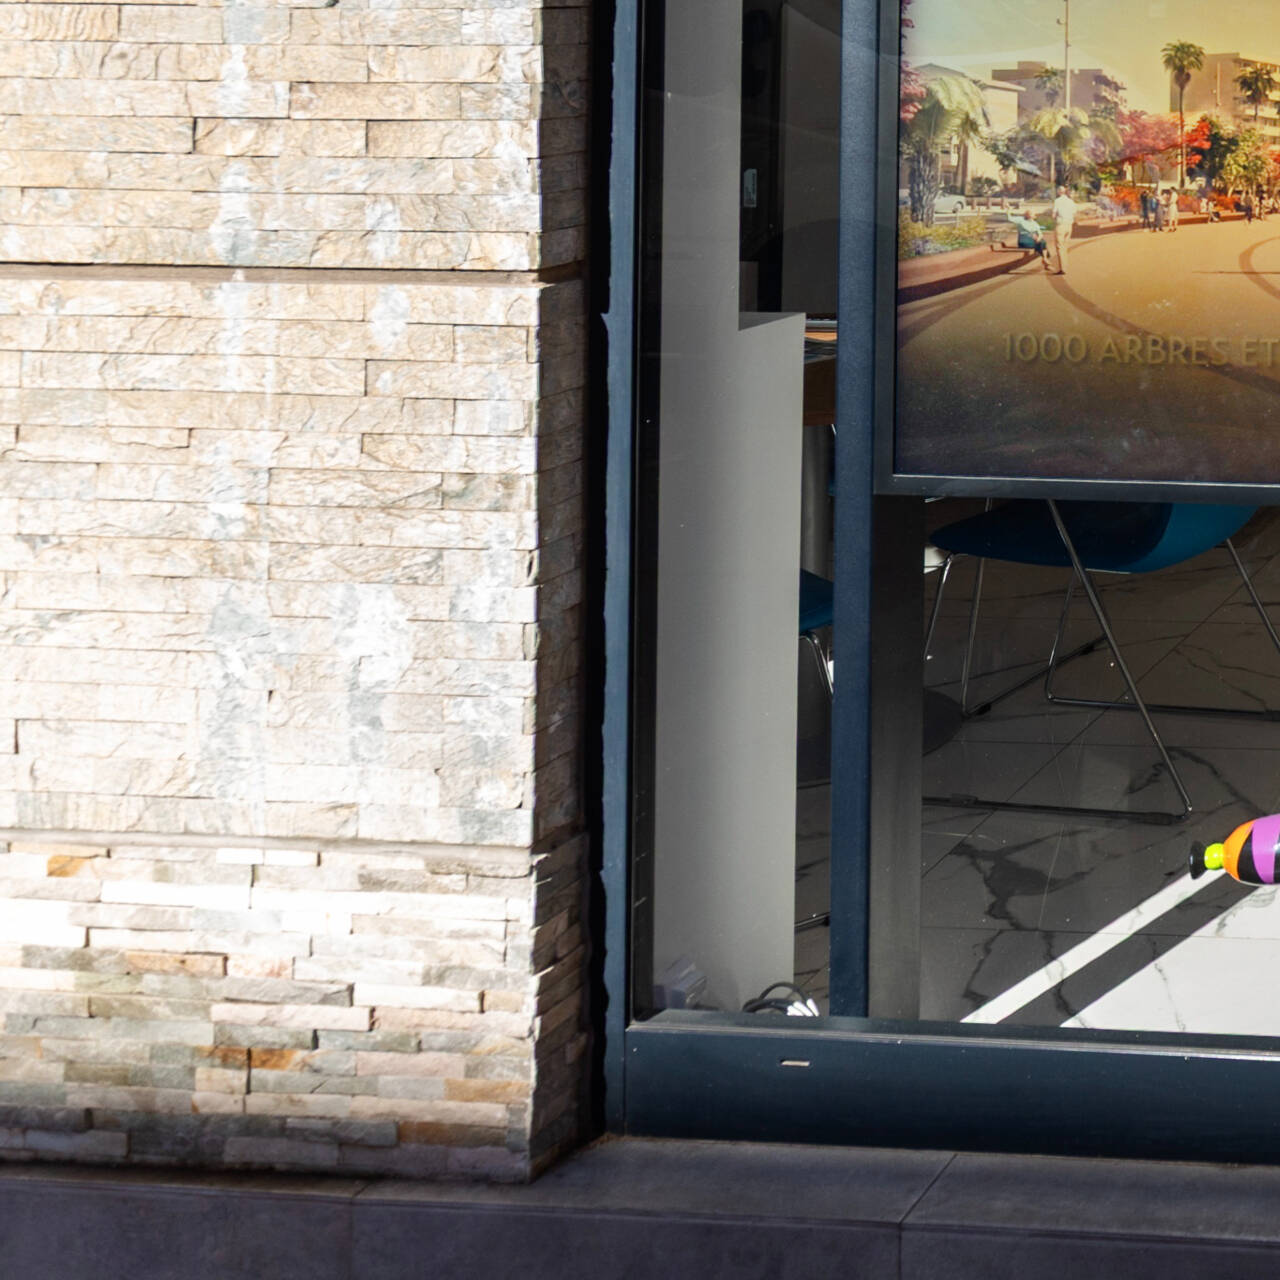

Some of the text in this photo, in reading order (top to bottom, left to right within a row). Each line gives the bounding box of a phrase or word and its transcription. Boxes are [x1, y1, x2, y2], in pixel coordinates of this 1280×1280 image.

[1001, 332, 1088, 364] 1000
[1100, 334, 1230, 367] ARBRES
[1239, 337, 1279, 368] ET
